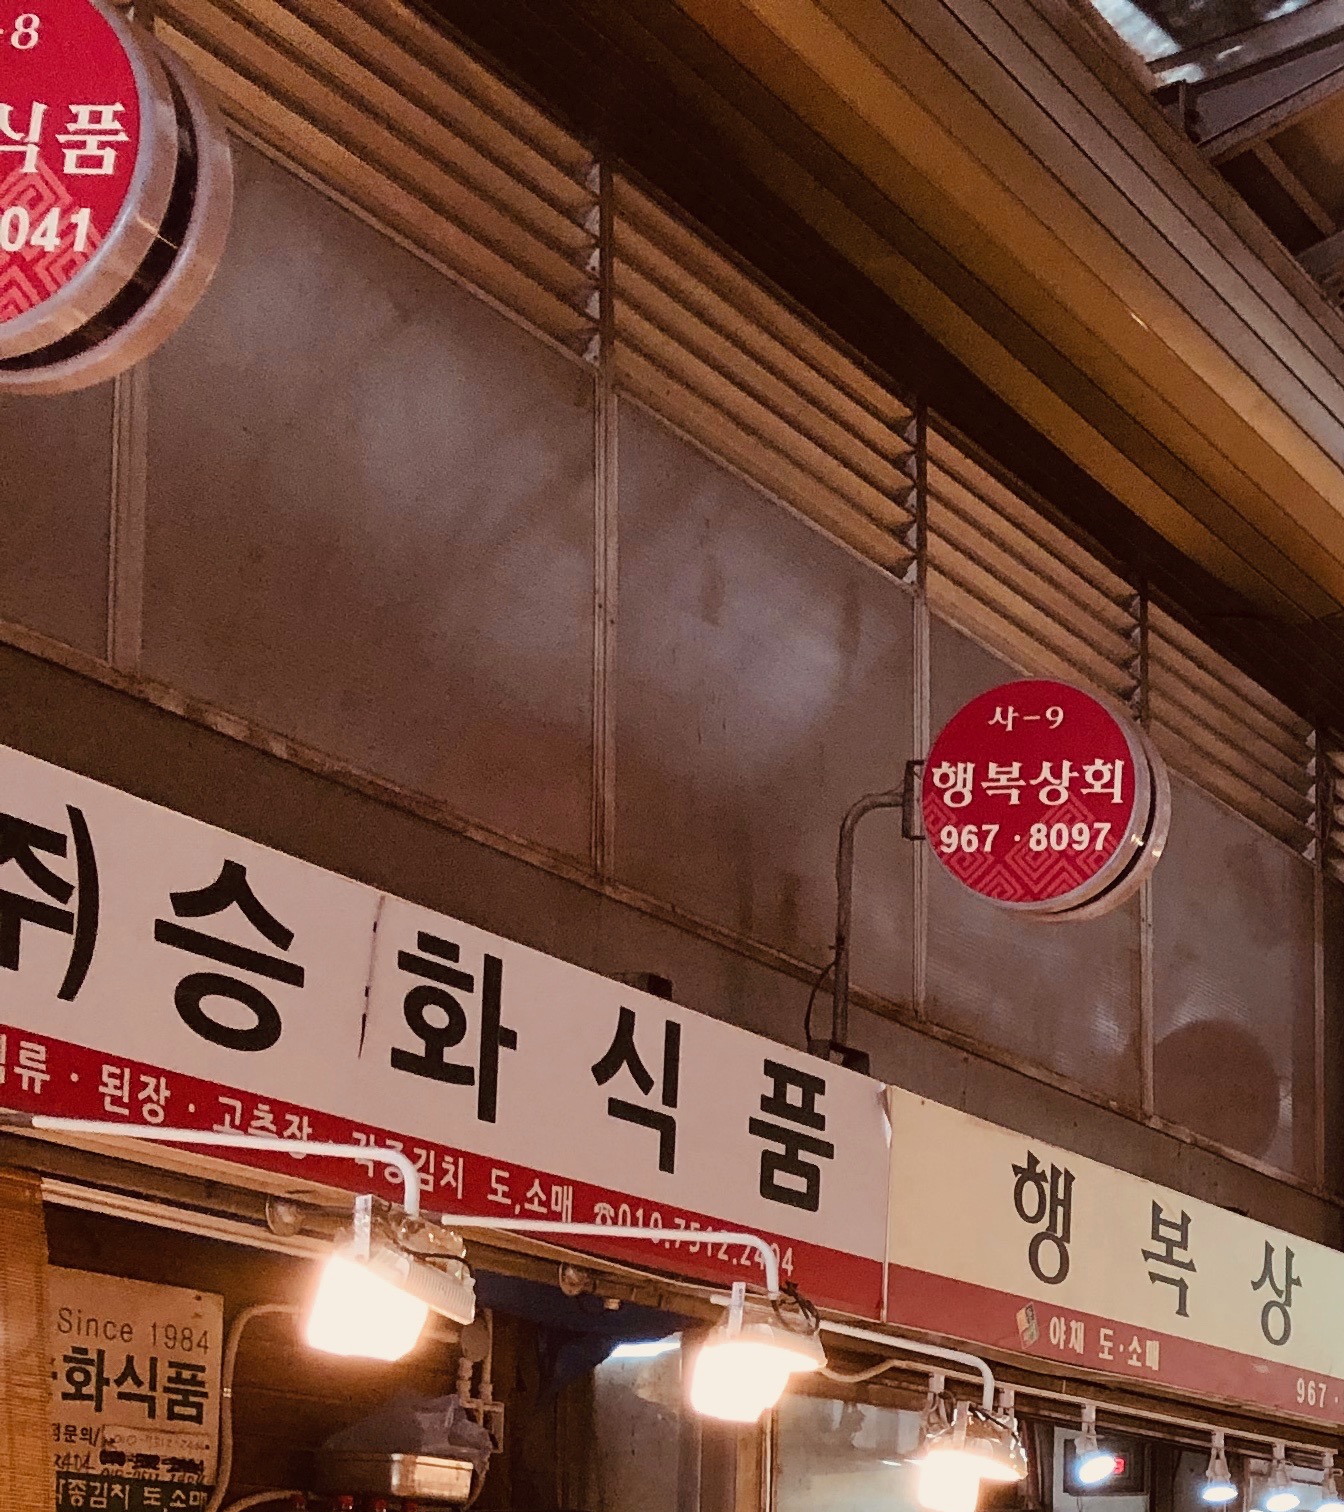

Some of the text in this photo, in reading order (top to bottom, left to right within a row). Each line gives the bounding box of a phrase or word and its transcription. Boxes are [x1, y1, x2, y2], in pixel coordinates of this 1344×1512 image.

[988, 705, 1065, 732] 사-9
[932, 759, 1125, 806] 행복상회
[99, 1063, 172, 1125] 된장
[57, 1307, 210, 1355] Since 1984
[1048, 1316, 1085, 1354] 야채
[50, 1346, 209, 1425] 화식품
